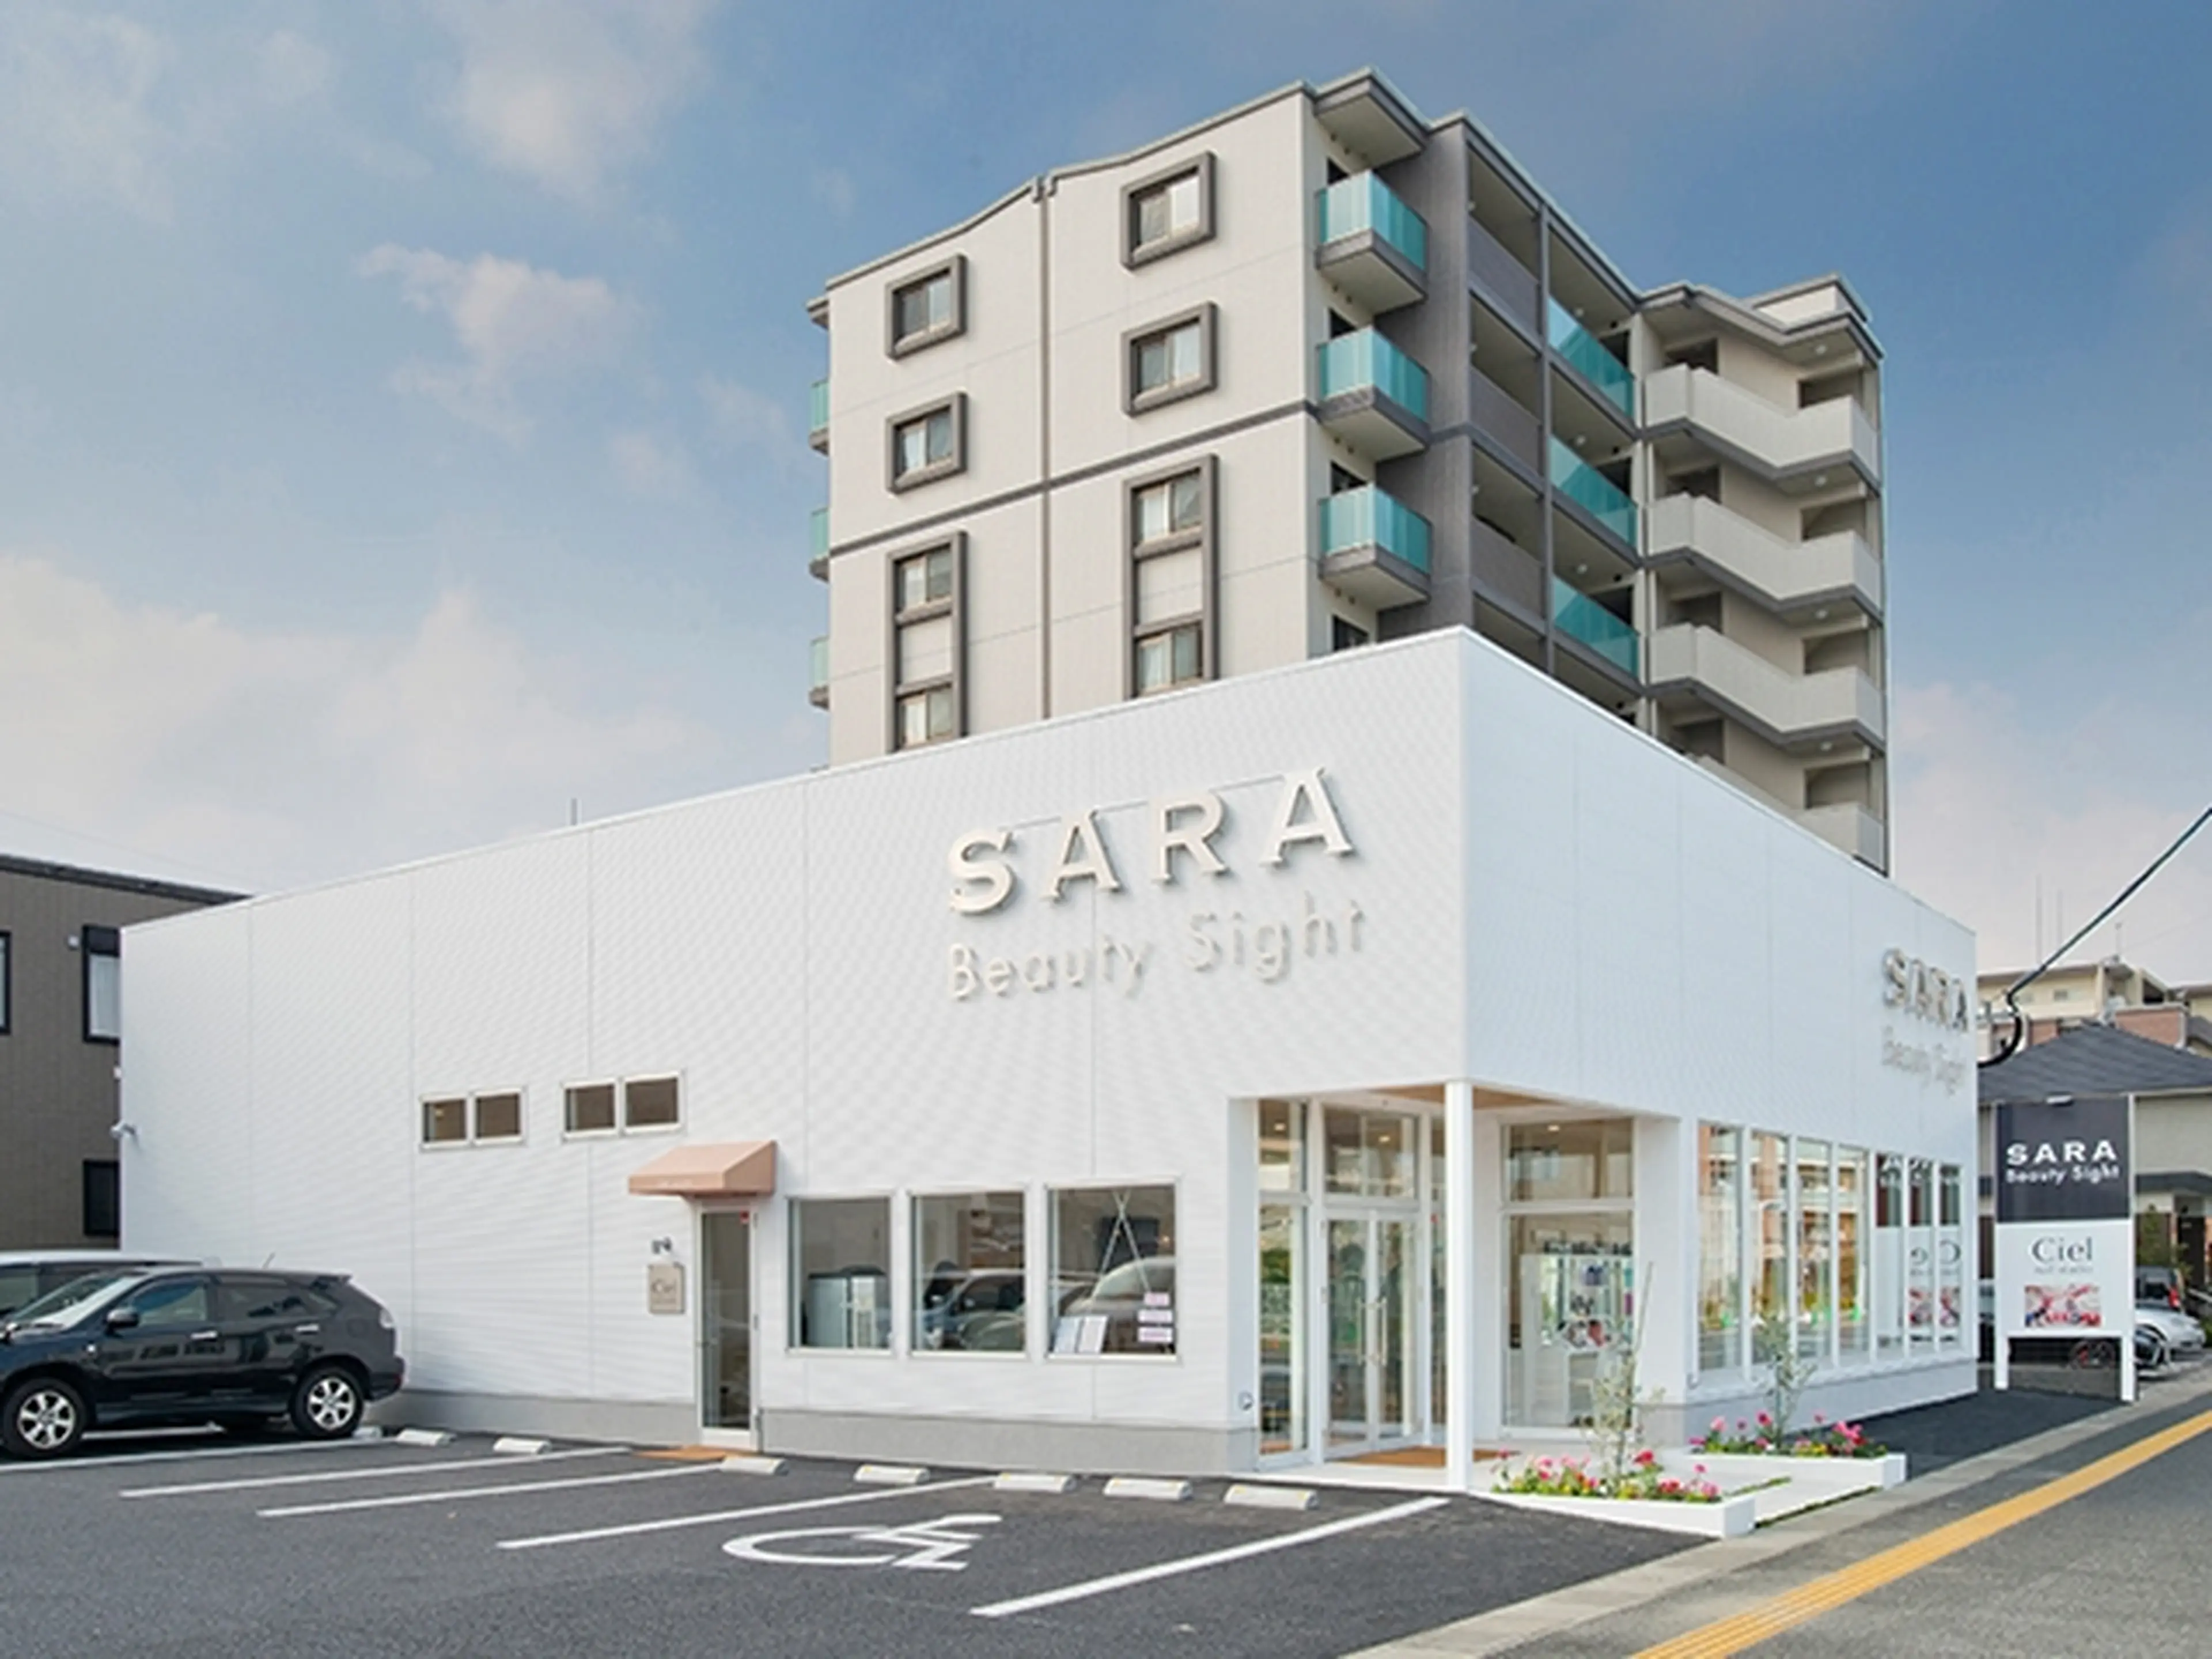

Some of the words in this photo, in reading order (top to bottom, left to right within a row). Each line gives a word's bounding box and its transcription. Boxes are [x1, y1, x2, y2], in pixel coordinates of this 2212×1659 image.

[948, 767, 1355, 915] SARA
[948, 931, 1149, 1002] Beauty
[1187, 891, 1365, 983] Sight
[1881, 948, 1969, 1033] SARA
[2006, 1140, 2117, 1165] SARA
[2031, 1237, 2092, 1263] Ciel
